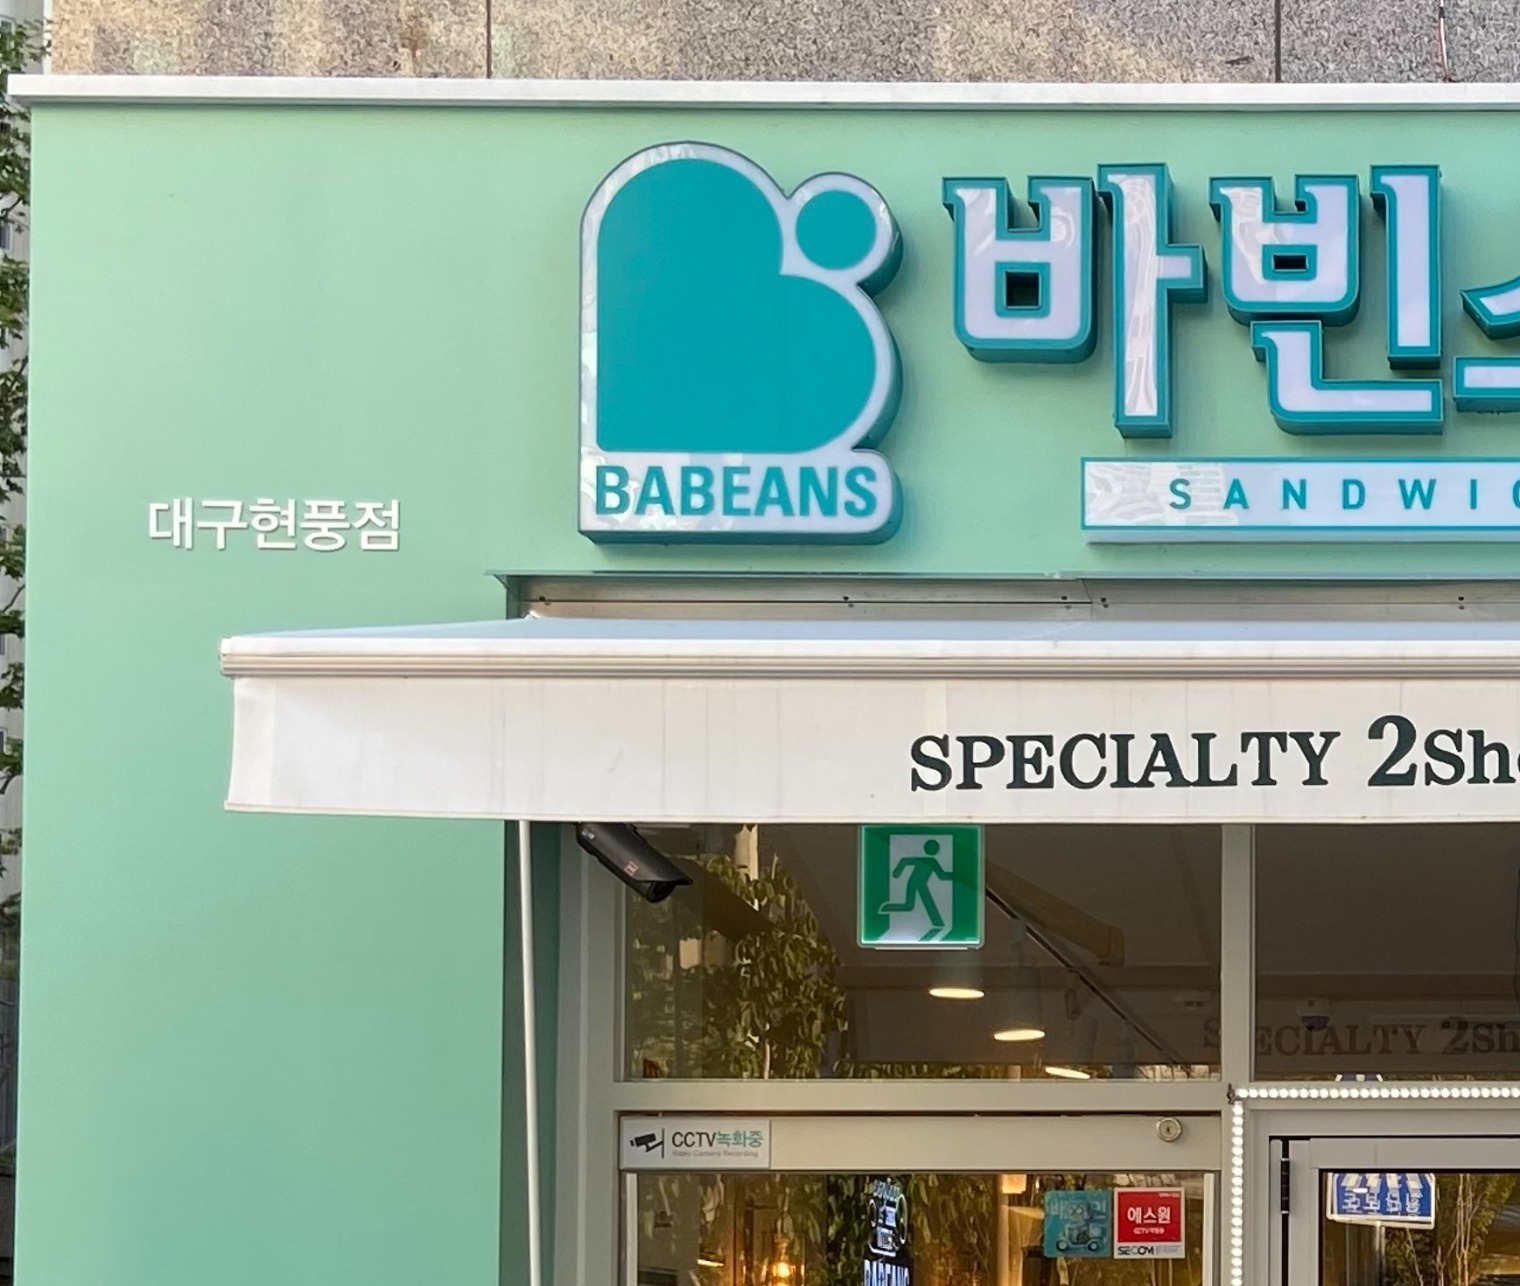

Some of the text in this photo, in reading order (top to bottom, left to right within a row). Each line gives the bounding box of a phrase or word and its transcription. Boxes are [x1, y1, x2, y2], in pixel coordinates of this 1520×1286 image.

[596, 464, 878, 518] BABEANS
[148, 499, 401, 551] 대구현풍점
[910, 731, 1341, 791] SPECIALTY
[1127, 1206, 1171, 1224] 에스원
[1117, 1245, 1154, 1256] SECOM
